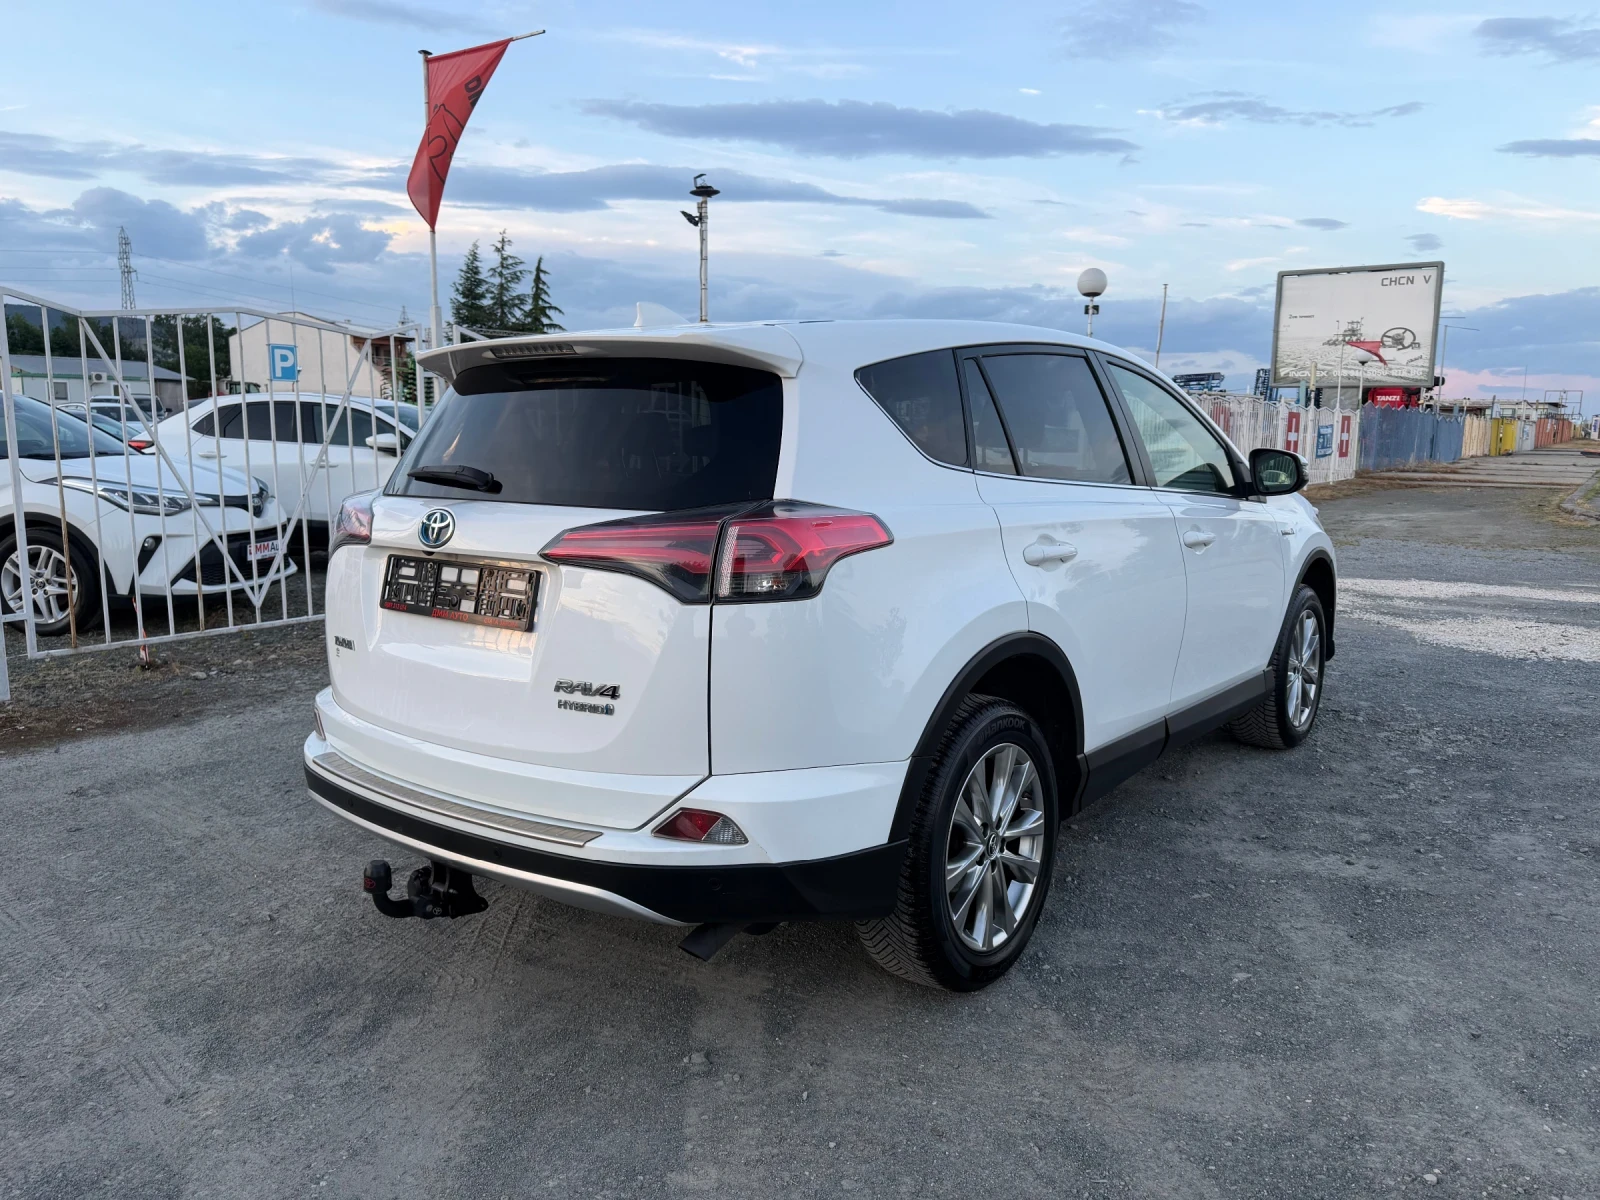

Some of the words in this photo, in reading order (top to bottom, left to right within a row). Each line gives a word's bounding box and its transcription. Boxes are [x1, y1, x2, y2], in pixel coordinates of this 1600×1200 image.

[274, 348, 295, 378] P
[554, 678, 621, 700] RAV4
[557, 699, 605, 715] HYBRID
